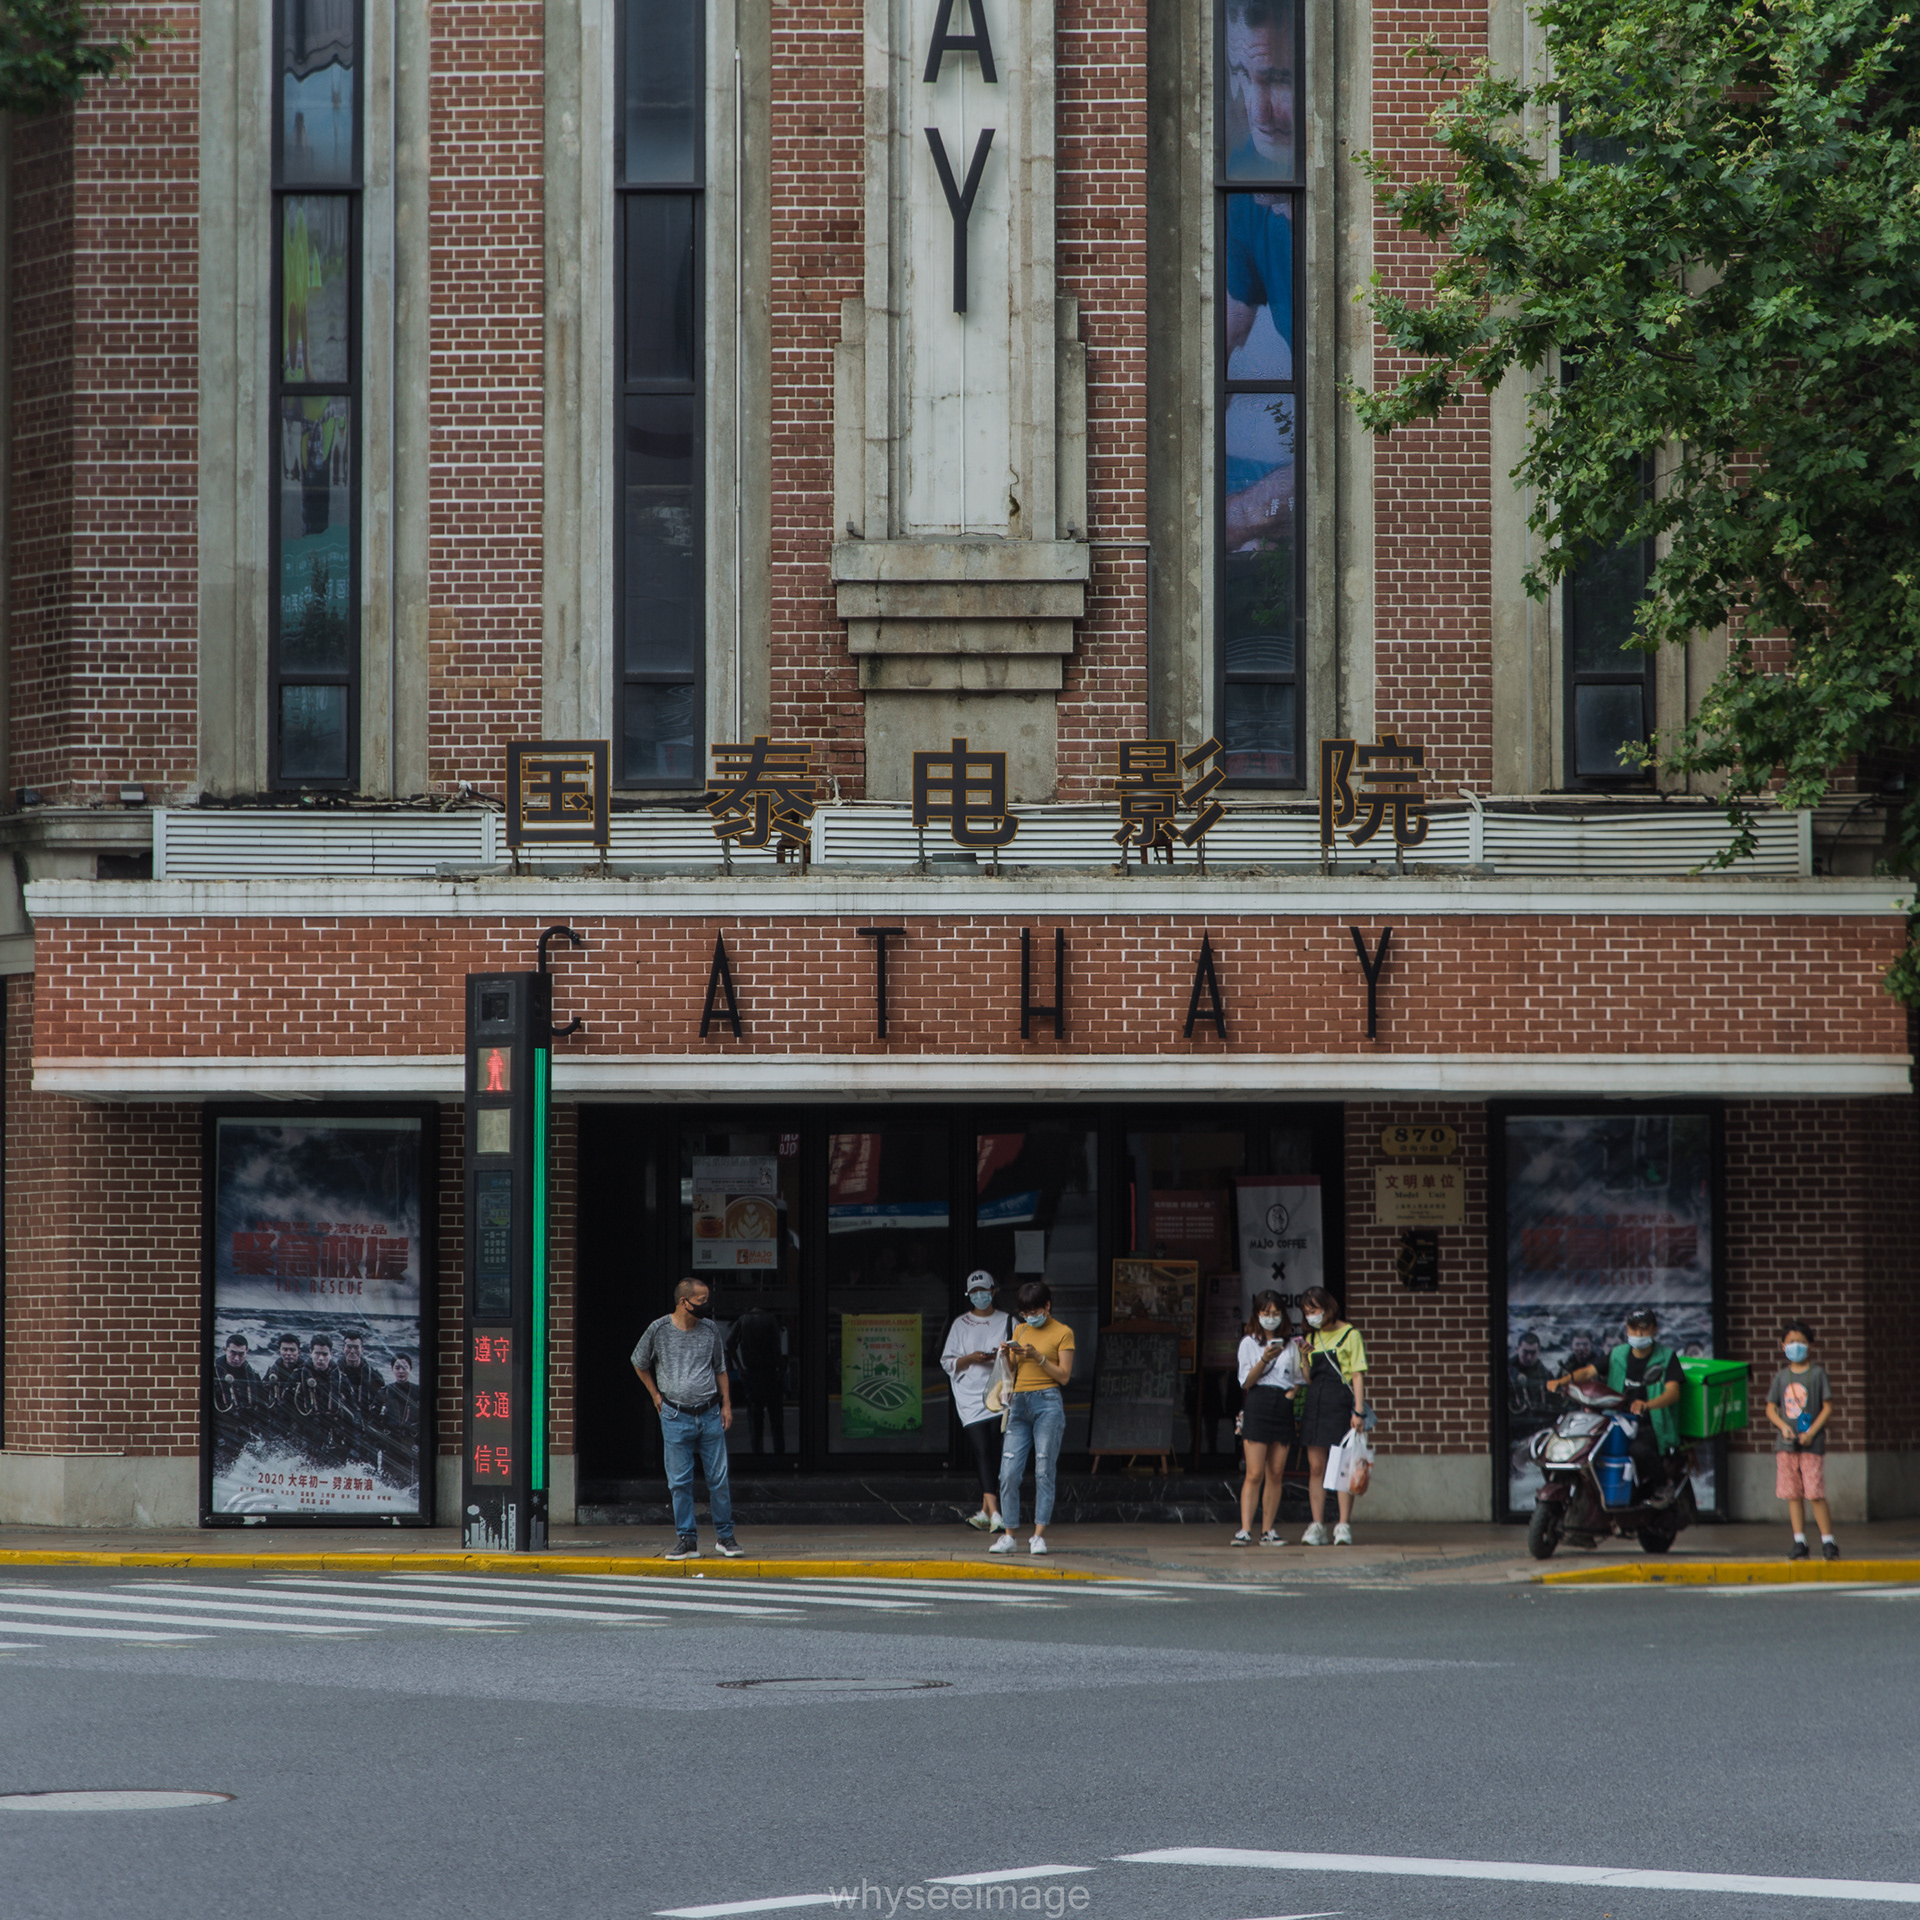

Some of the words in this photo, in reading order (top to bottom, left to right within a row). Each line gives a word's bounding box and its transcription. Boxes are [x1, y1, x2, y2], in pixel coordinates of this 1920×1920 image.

[505, 734, 1430, 848] 国泰电影院
[537, 926, 1393, 1039] CATHAY
[1394, 1128, 1445, 1143] 870
[1384, 1174, 1455, 1189] 文明单位
[232, 1232, 409, 1280] 紧急救援
[1250, 1238, 1274, 1249] MAJO
[1276, 1238, 1307, 1249] COFFEE
[276, 1279, 300, 1293] THE
[309, 1280, 363, 1295] RESCUE
[474, 1335, 510, 1363] 遵守
[474, 1391, 510, 1418] 交通
[474, 1444, 512, 1476] 信号
[258, 1473, 284, 1485] 2020
[288, 1474, 329, 1489] 大年初一
[332, 1476, 374, 1492] 劈波斩浪
